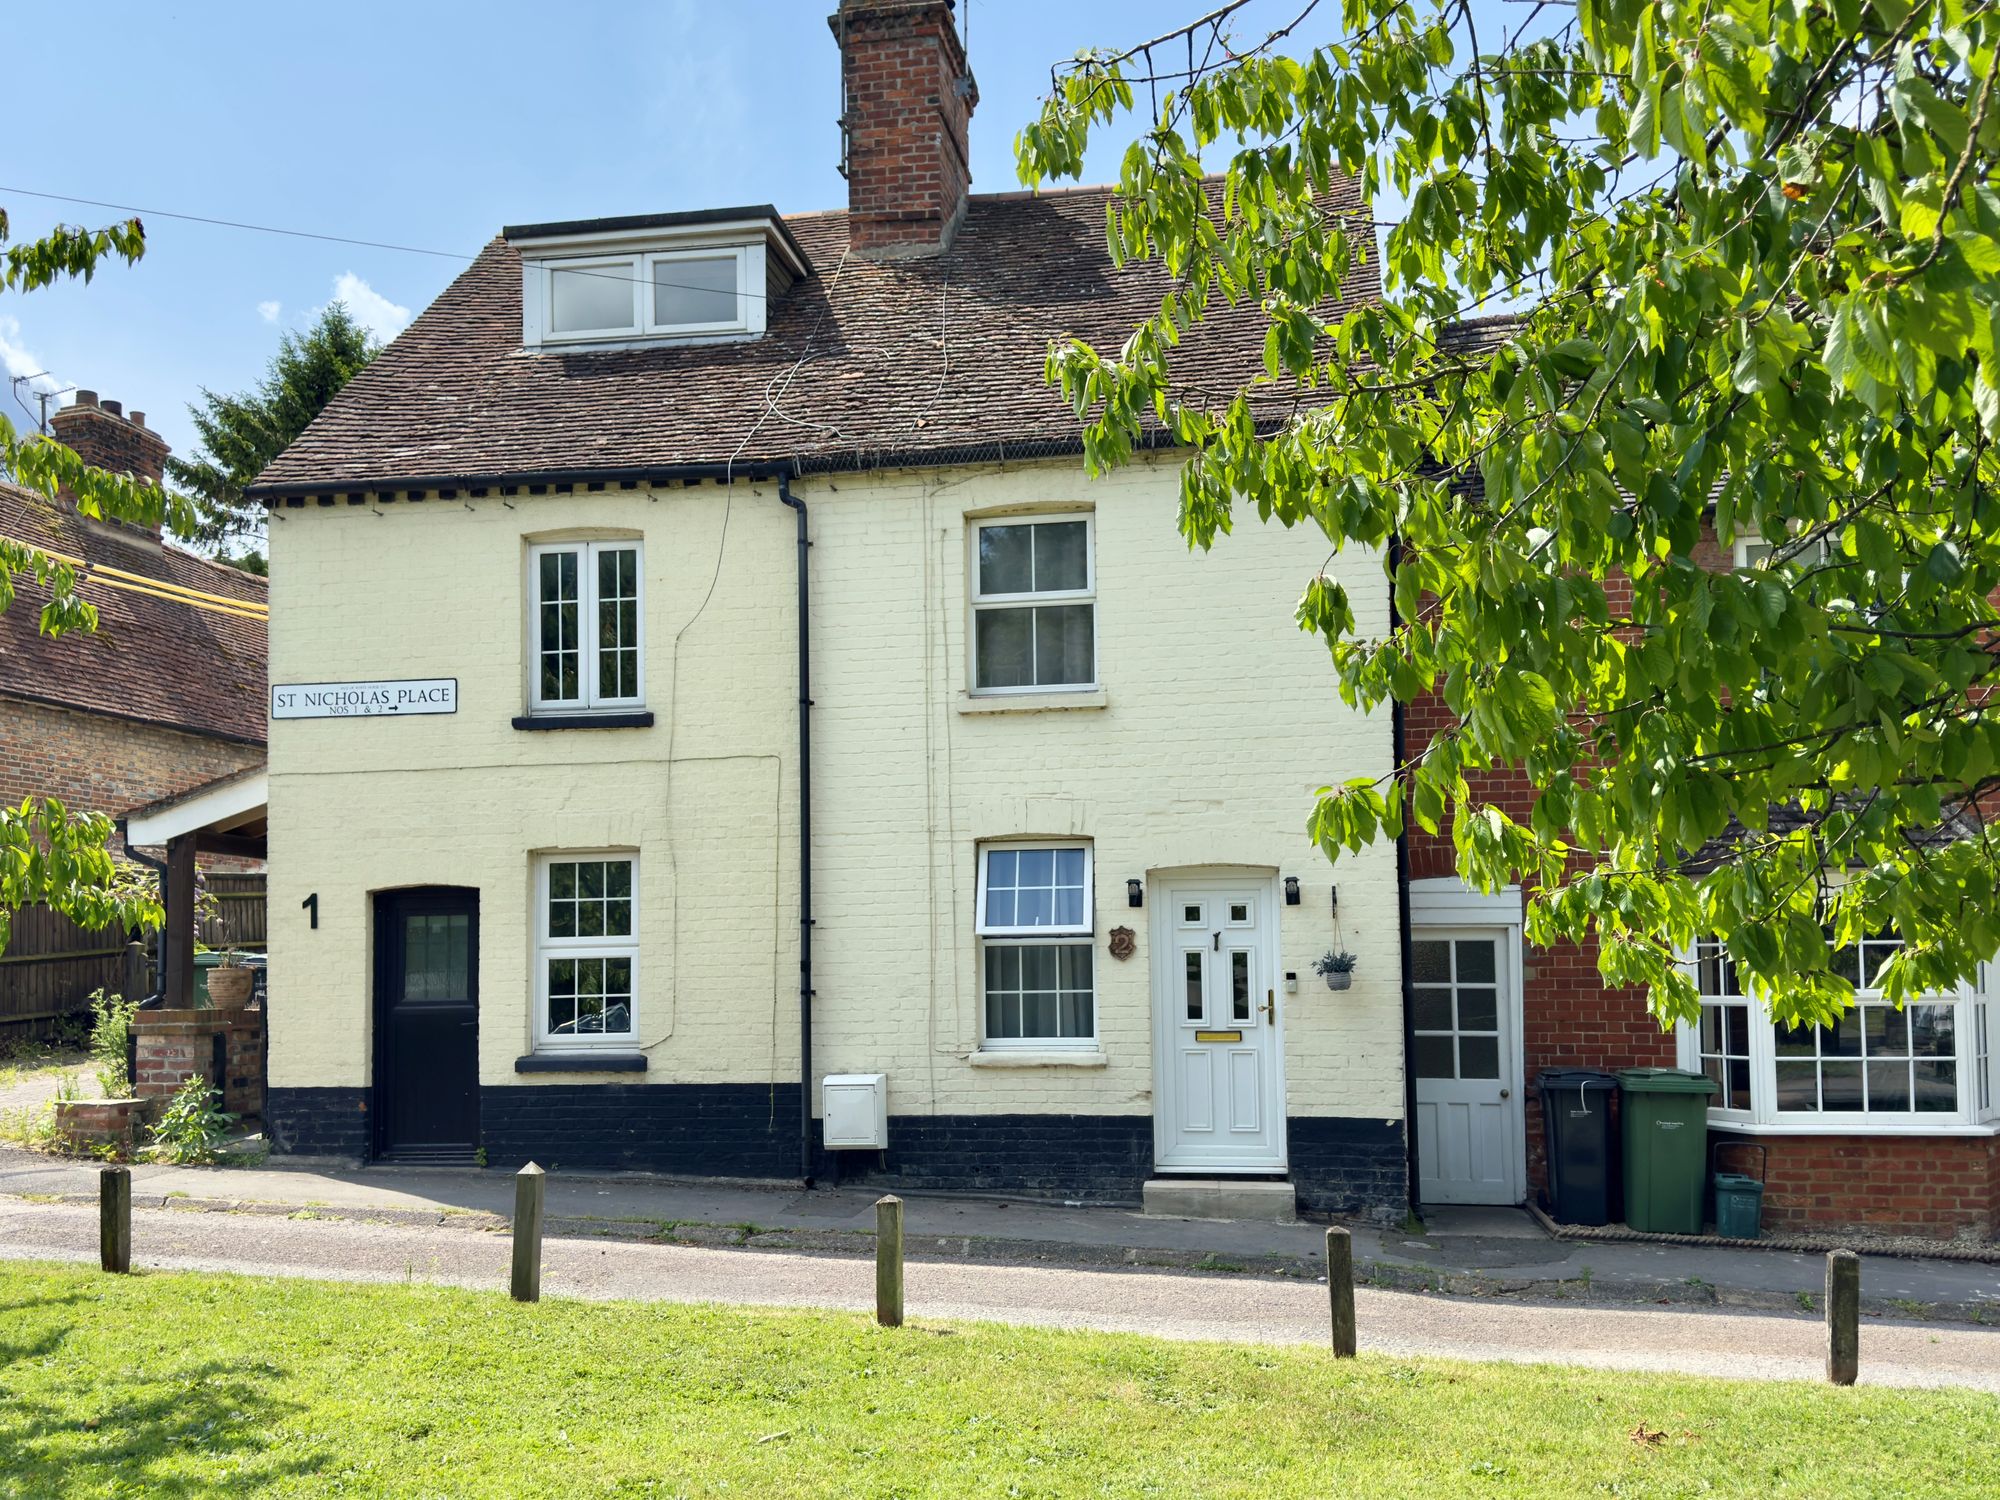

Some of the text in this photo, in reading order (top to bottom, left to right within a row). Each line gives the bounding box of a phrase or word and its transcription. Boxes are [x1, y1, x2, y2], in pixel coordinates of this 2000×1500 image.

[277, 688, 450, 708] ST NICHOLAS PLACE
[329, 706, 349, 715] NOS
[364, 705, 371, 714] &
[378, 704, 383, 713] 2
[302, 893, 317, 929] 1
[1114, 934, 1131, 954] 2
